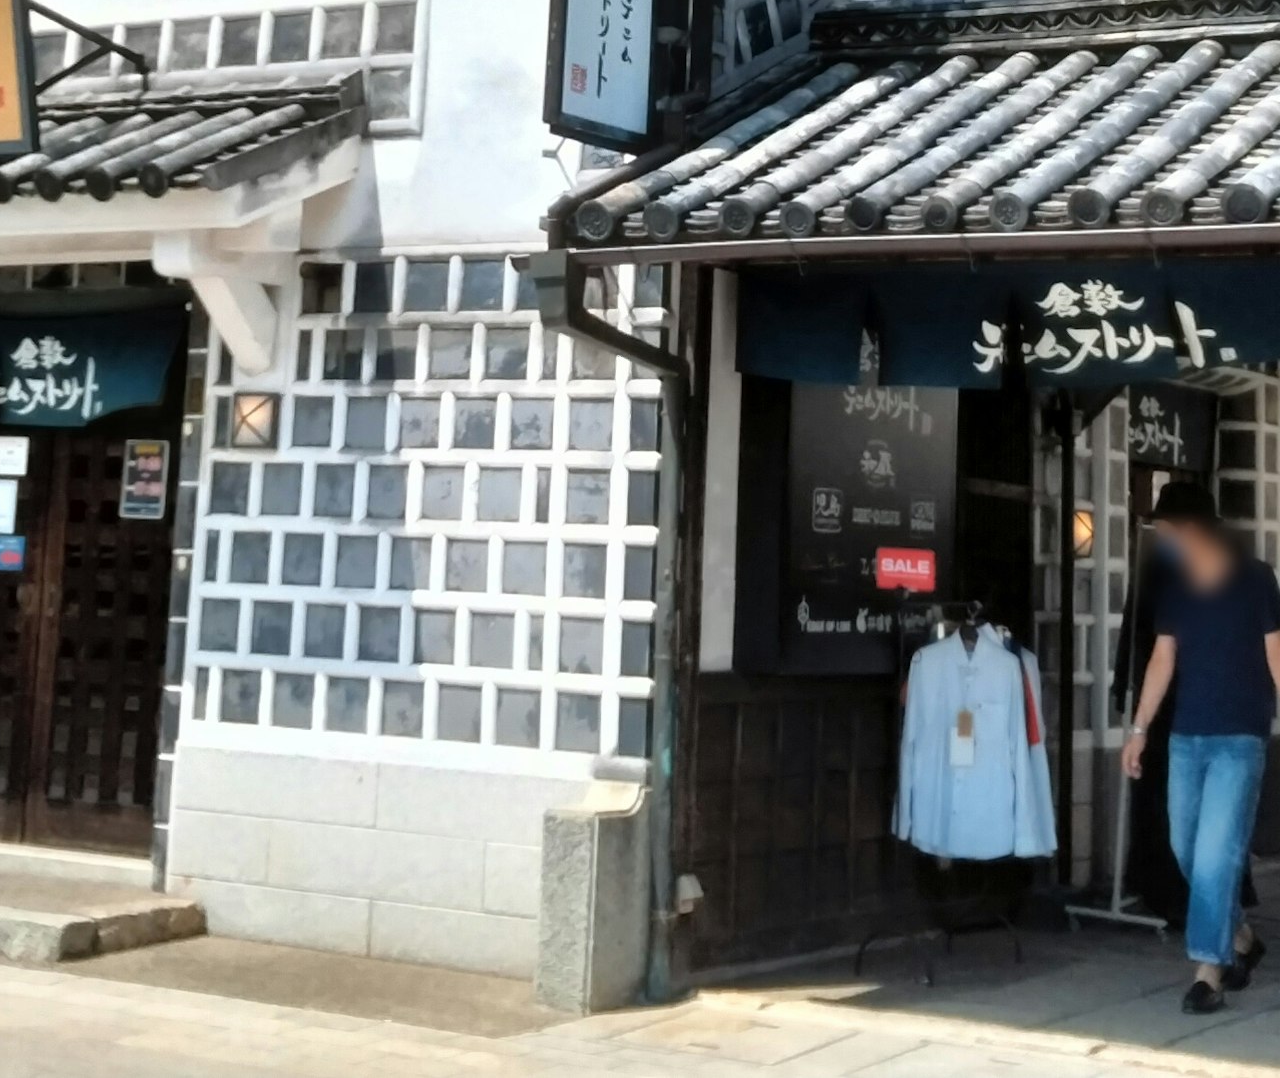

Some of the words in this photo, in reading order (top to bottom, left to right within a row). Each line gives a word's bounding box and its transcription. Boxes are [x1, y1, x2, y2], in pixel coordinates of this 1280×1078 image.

[1034, 279, 1146, 318] 倉敷
[9, 335, 78, 370] 倉敷
[880, 557, 931, 575] SALE
